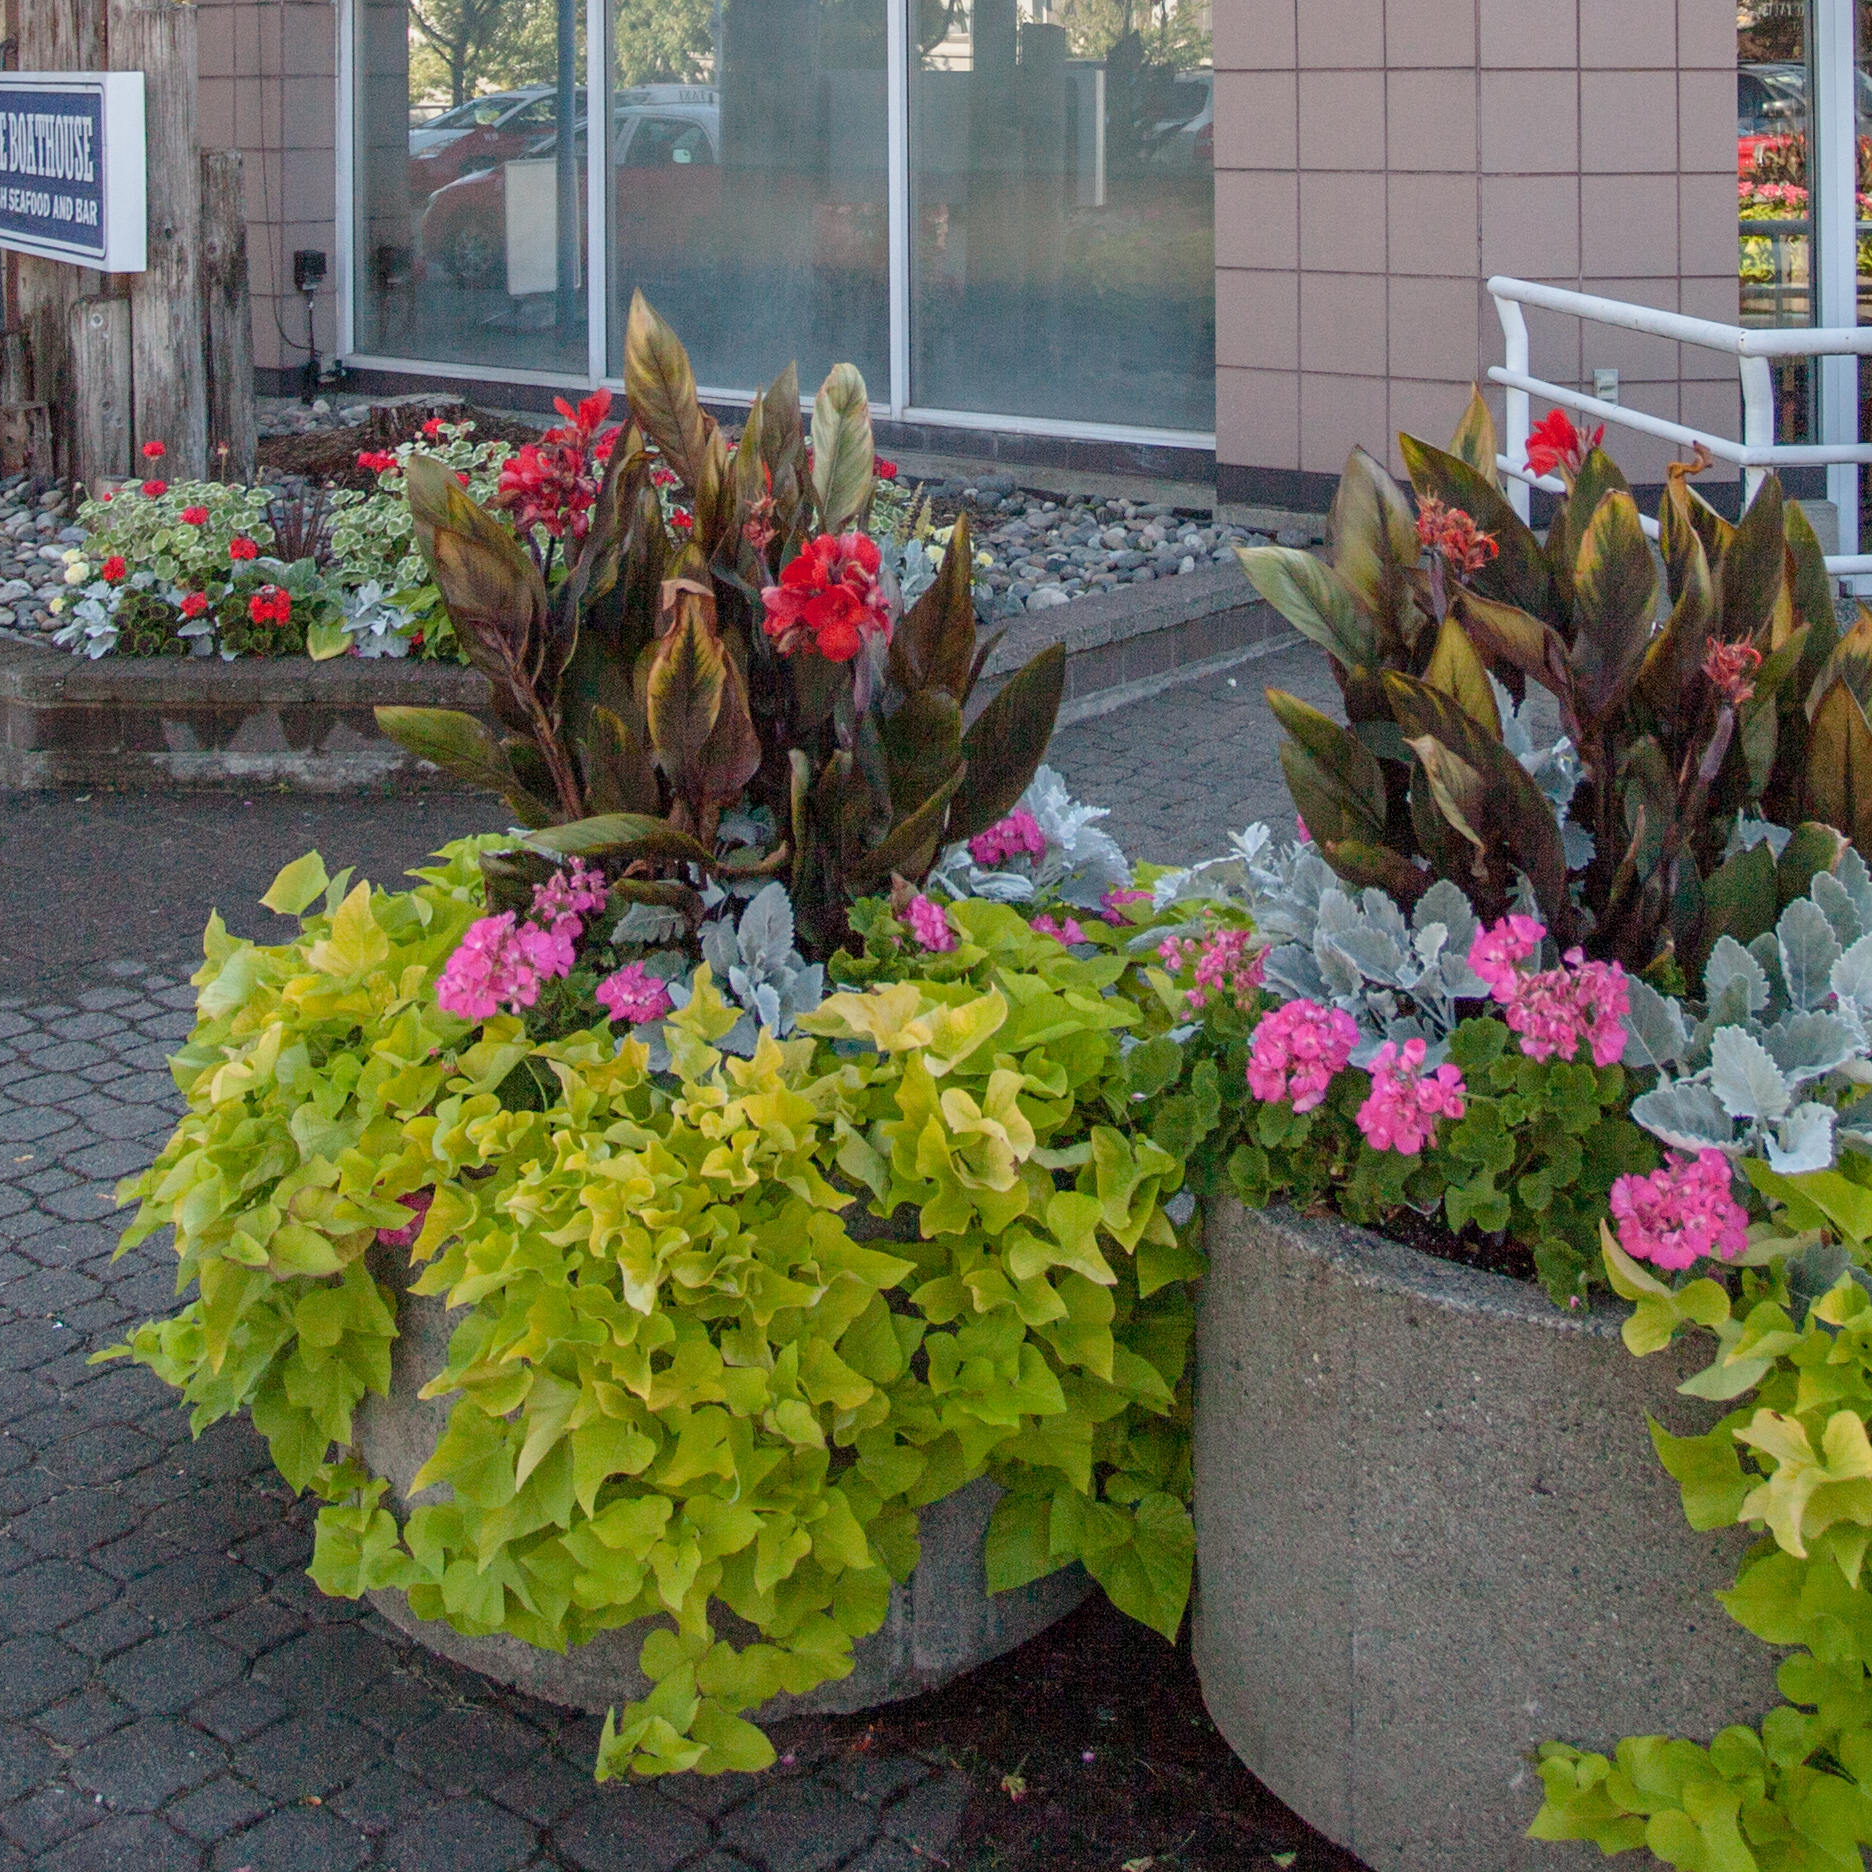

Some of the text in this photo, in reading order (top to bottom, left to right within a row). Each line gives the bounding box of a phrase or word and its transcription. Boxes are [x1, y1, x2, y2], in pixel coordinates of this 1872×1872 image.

[8, 111, 94, 183] BOATHOUSE
[8, 187, 50, 218] SEAFOOD
[52, 194, 74, 222] AND
[75, 198, 98, 226] BAR
